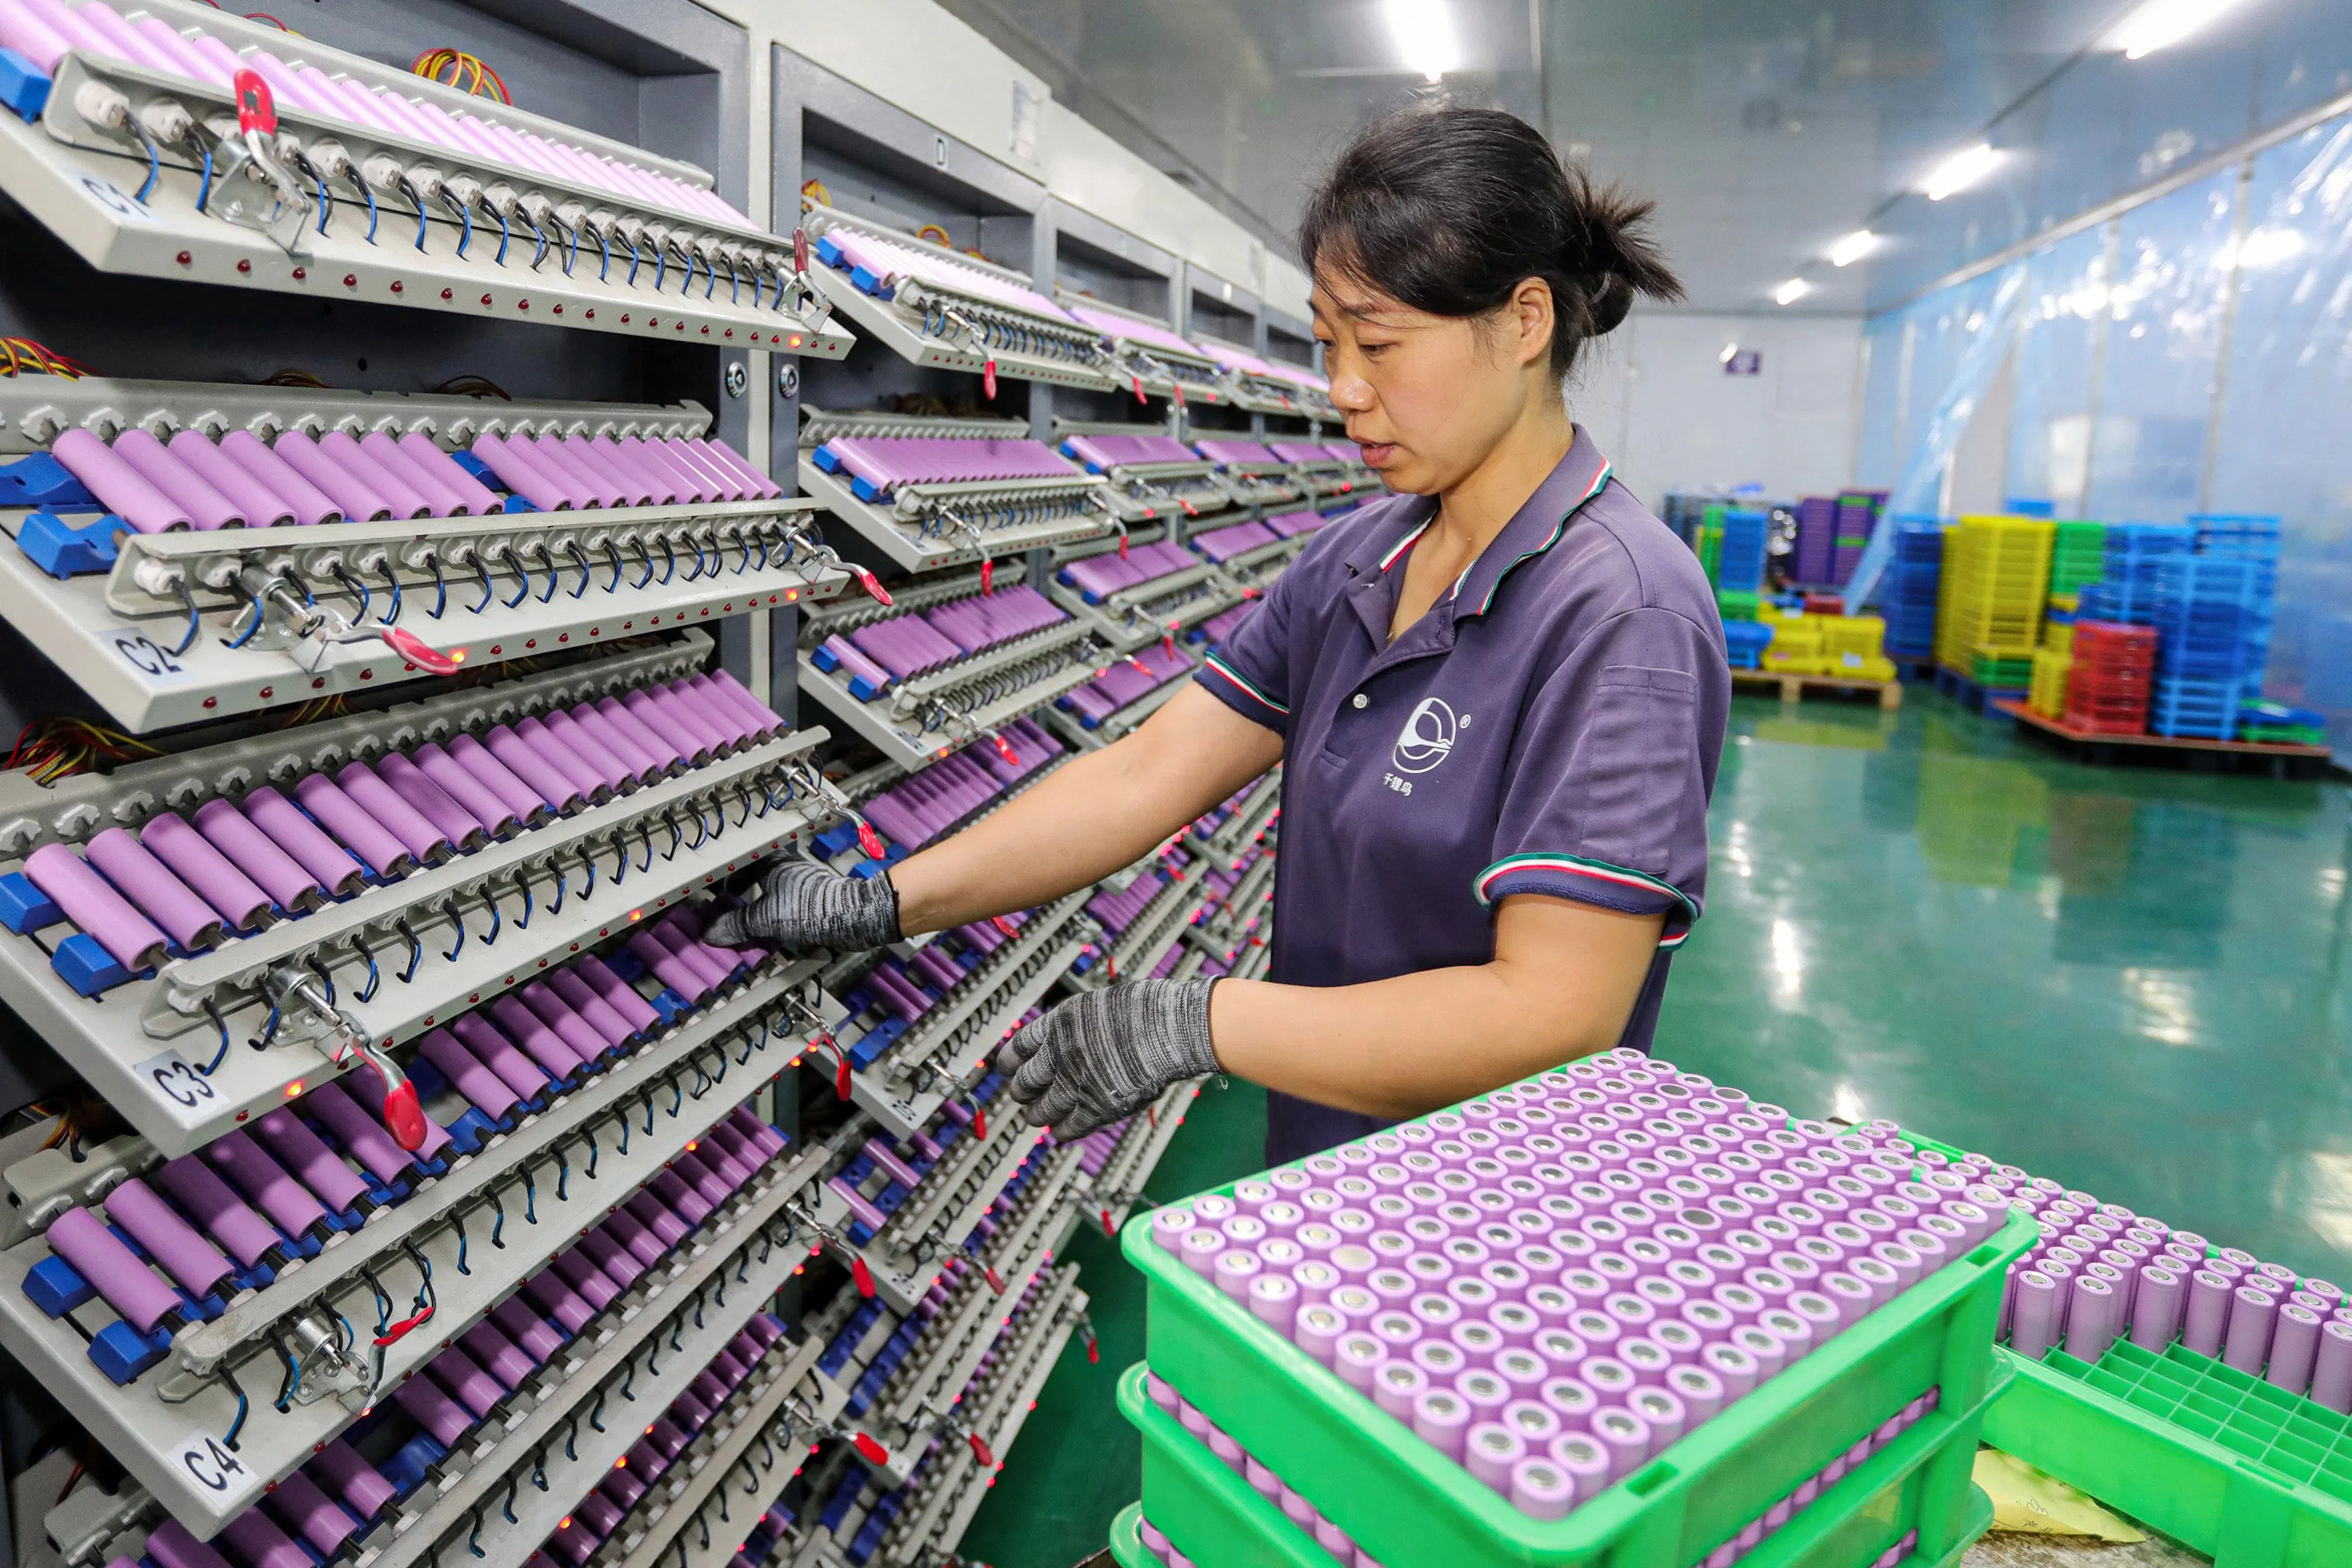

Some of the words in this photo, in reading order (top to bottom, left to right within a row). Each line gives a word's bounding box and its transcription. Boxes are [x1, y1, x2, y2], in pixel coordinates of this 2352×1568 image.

[82, 178, 149, 218] C1
[116, 636, 184, 676] C2
[153, 1061, 215, 1107] C3
[184, 1437, 245, 1491] C4
